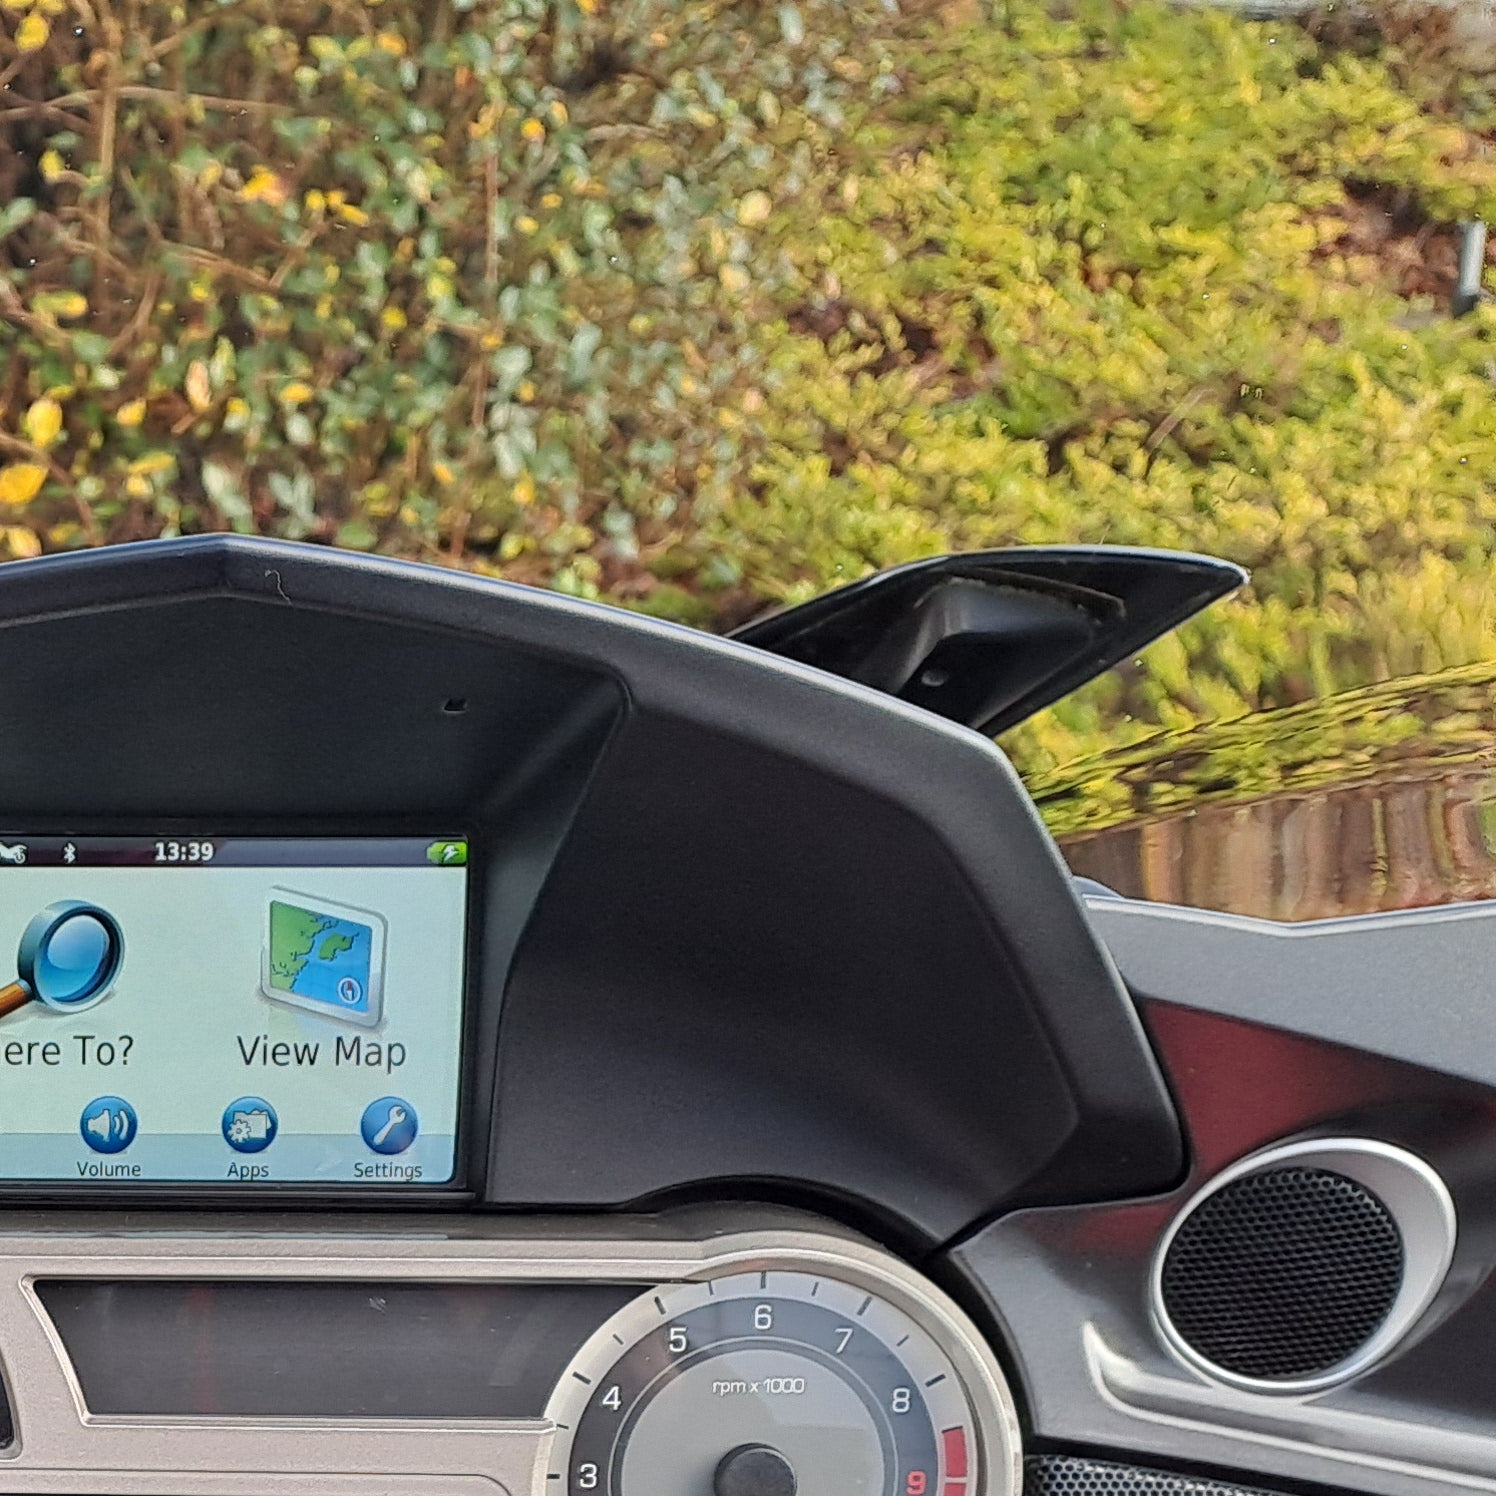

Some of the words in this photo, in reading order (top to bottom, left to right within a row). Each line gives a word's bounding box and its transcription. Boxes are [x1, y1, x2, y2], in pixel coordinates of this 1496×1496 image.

[155, 842, 214, 861] 13:39
[73, 1035, 134, 1067] To?
[237, 1035, 319, 1067] View
[335, 1036, 406, 1074] Map
[77, 1161, 141, 1177] Volume
[227, 1162, 269, 1181] Apps
[354, 1161, 423, 1180] Settings
[754, 1306, 771, 1329] 6
[669, 1328, 687, 1352] 5
[834, 1329, 853, 1353] 7
[603, 1387, 621, 1409] 4
[712, 1381, 747, 1395] rpm
[763, 1379, 805, 1393] 1000
[892, 1389, 910, 1412] 8
[579, 1465, 598, 1487] 3
[907, 1472, 926, 1495] 9
